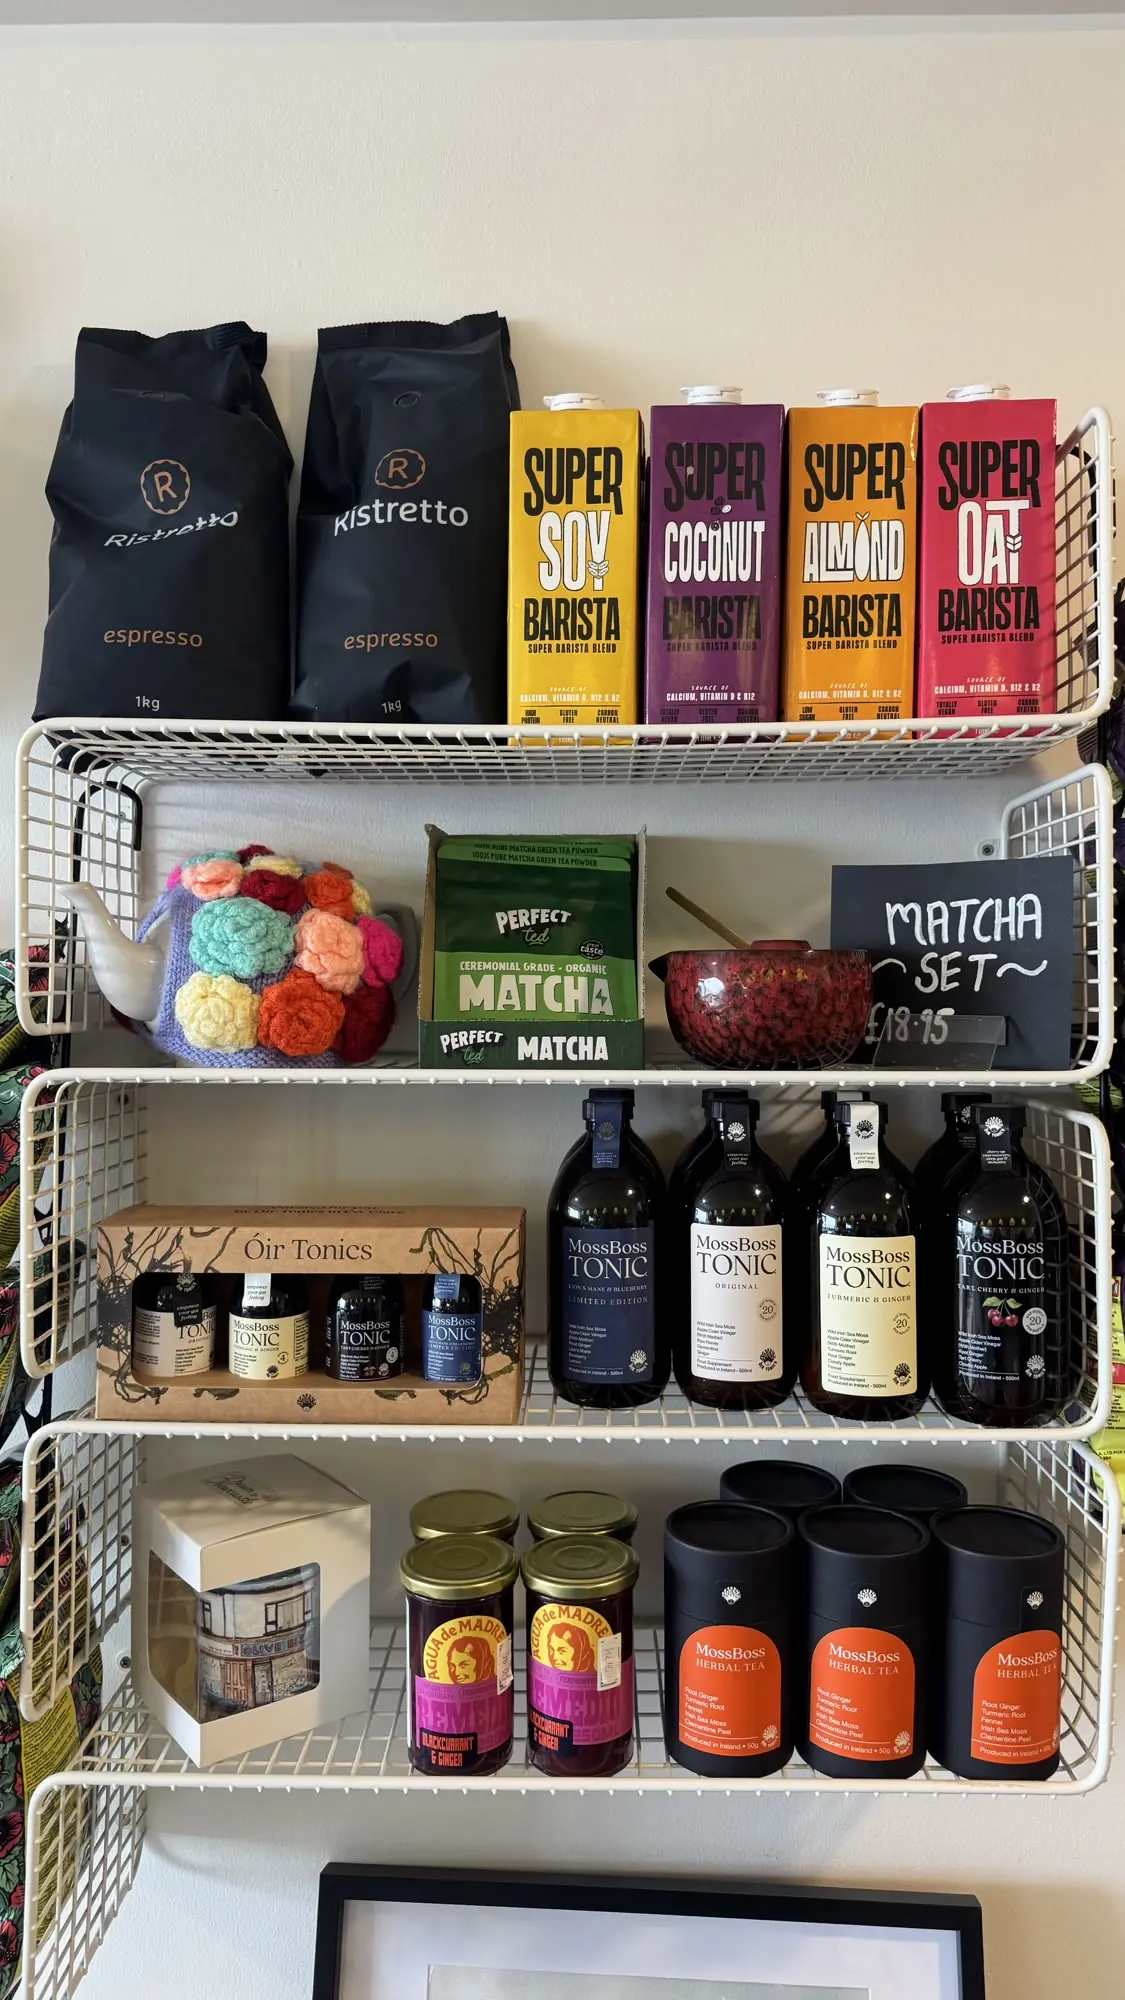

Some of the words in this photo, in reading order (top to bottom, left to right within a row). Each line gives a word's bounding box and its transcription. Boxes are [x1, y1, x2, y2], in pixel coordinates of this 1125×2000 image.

[388, 458, 408, 479] R
[664, 442, 765, 512] SUPER
[803, 442, 905, 512] SUPER
[938, 439, 1041, 511] SUPER
[154, 471, 178, 502] R
[523, 447, 623, 516] SUPER
[334, 499, 469, 537] Ristretto
[103, 511, 239, 547] Ristretto
[538, 510, 611, 592] SOY
[664, 520, 765, 583] COCONUT
[802, 517, 905, 583] ALMOND
[957, 499, 1030, 586] OAT
[662, 595, 761, 640] BARISTA
[802, 593, 901, 639] BARISTA
[937, 586, 1039, 632] BARISTA
[523, 597, 620, 641] BARISTA
[103, 628, 203, 647] espresso
[344, 632, 438, 652] espresso
[806, 640, 832, 650] SUPER
[835, 640, 872, 650] BARISTA
[873, 640, 897, 649] BLEND
[941, 634, 968, 645] SUPER
[971, 633, 1006, 643] BARISTA
[1009, 632, 1035, 642] BLEND
[528, 643, 552, 653] SUPER
[555, 643, 589, 653] BARISTA
[592, 643, 616, 653] BLEND
[135, 696, 160, 711] 1kg
[666, 693, 698, 702] CALCIUM,
[700, 692, 728, 701] VITAMIN
[731, 692, 735, 701] D
[744, 692, 756, 701] B12
[381, 700, 402, 714] 1kg
[472, 851, 489, 859] 100%
[490, 853, 507, 861] PURE
[508, 854, 535, 863] MATCHA
[536, 856, 557, 864] GREEN
[557, 857, 570, 865] TEA
[570, 858, 598, 867] POWDER
[495, 908, 572, 934] PERFECT
[885, 893, 1043, 946] MATCHA
[522, 927, 550, 946] ted
[580, 945, 604, 956] taste
[459, 961, 521, 972] CEREMONIAL
[523, 962, 556, 973] GRADE
[565, 964, 607, 975] ORGANIC
[914, 951, 998, 993] SET
[459, 974, 614, 1016] MATCHA
[864, 1001, 955, 1045] £18.95
[439, 1030, 504, 1054] PERFECT
[517, 1036, 609, 1061] MATCHA
[462, 1047, 485, 1065] ted
[244, 1232, 285, 1260] Óir
[291, 1238, 373, 1260] Tonics
[568, 1237, 647, 1255] MossBoss
[697, 1234, 776, 1251] MossBoss
[956, 1235, 1044, 1254] MossBoss
[696, 1252, 777, 1276] TONIC
[826, 1246, 910, 1264] MossBoss
[568, 1255, 648, 1279] TONIC
[956, 1254, 1045, 1280] TONIC
[826, 1264, 911, 1289] TONIC
[715, 1282, 759, 1290] ORIGINAL
[957, 1283, 976, 1292] TART
[977, 1286, 1009, 1294] CHERRY
[1018, 1286, 1045, 1294] GINGER
[568, 1296, 606, 1305] LIMITED
[610, 1296, 648, 1305] EDITION
[827, 1293, 870, 1303] TURMERIC
[882, 1295, 911, 1303] GINGER
[762, 1305, 774, 1314] 20
[233, 1319, 280, 1332] MossBoss
[340, 1319, 390, 1331] MossBoss
[428, 1314, 476, 1325] MossBoss
[896, 1319, 908, 1328] 20
[1029, 1316, 1041, 1326] 20
[233, 1329, 280, 1347] TONIC
[340, 1330, 391, 1346] TONIC
[428, 1326, 476, 1341] TONIC
[531, 1616, 545, 1660] AGUA
[542, 1609, 557, 1622] de
[557, 1605, 609, 1640] MADRE
[242, 1642, 281, 1656] OLIVE
[425, 1639, 444, 1681] AGUA
[440, 1626, 458, 1642] de
[458, 1618, 505, 1643] MADRE
[696, 1641, 766, 1660] MossBoss
[829, 1642, 900, 1663] MossBoss
[997, 1648, 1058, 1667] MossBoss
[696, 1657, 741, 1672] HERBAL
[744, 1661, 765, 1672] TEA
[829, 1659, 874, 1675] HERBAL
[878, 1665, 899, 1675] TEA
[997, 1669, 1040, 1679] HERBAL
[1044, 1663, 1057, 1677] TEA
[684, 1686, 698, 1697] Root
[698, 1691, 720, 1703] Ginger
[684, 1694, 709, 1709] Turmeric
[709, 1702, 725, 1711] Root
[816, 1686, 830, 1698] Root
[831, 1692, 852, 1704] Ginger
[684, 1703, 703, 1714] Fennel
[816, 1695, 841, 1710] Turmeric
[841, 1703, 857, 1713] Root
[816, 1703, 835, 1716] Fennel
[981, 1700, 998, 1709] Root
[999, 1702, 1021, 1713] Ginger
[684, 1711, 696, 1720] Irish
[697, 1715, 708, 1724] Sea
[709, 1718, 727, 1727] Moss
[816, 1711, 828, 1721] Irish
[829, 1716, 840, 1725] Sea
[841, 1720, 859, 1730] Moss
[981, 1709, 1011, 1718] Turmeric
[981, 1717, 1003, 1726] Fennel
[684, 1719, 716, 1734] Clementine
[717, 1727, 732, 1736] Peel
[815, 1719, 849, 1736] Clementine
[849, 1729, 864, 1739] Peel
[980, 1724, 996, 1733] Irish
[996, 1726, 1010, 1734] Sea
[421, 1731, 475, 1752] BLACKCURRANT
[538, 1731, 559, 1752] GINGER
[684, 1732, 712, 1748] Produced
[719, 1741, 741, 1750] Ireland
[747, 1742, 759, 1751] 50g
[815, 1732, 843, 1750] Produced
[850, 1745, 873, 1754] Ireland
[878, 1748, 891, 1756] 50g
[980, 1732, 1017, 1742] Clementine
[438, 1752, 463, 1767] GINGER
[979, 1746, 1012, 1757] Produced
[1019, 1749, 1039, 1757] Ireland
